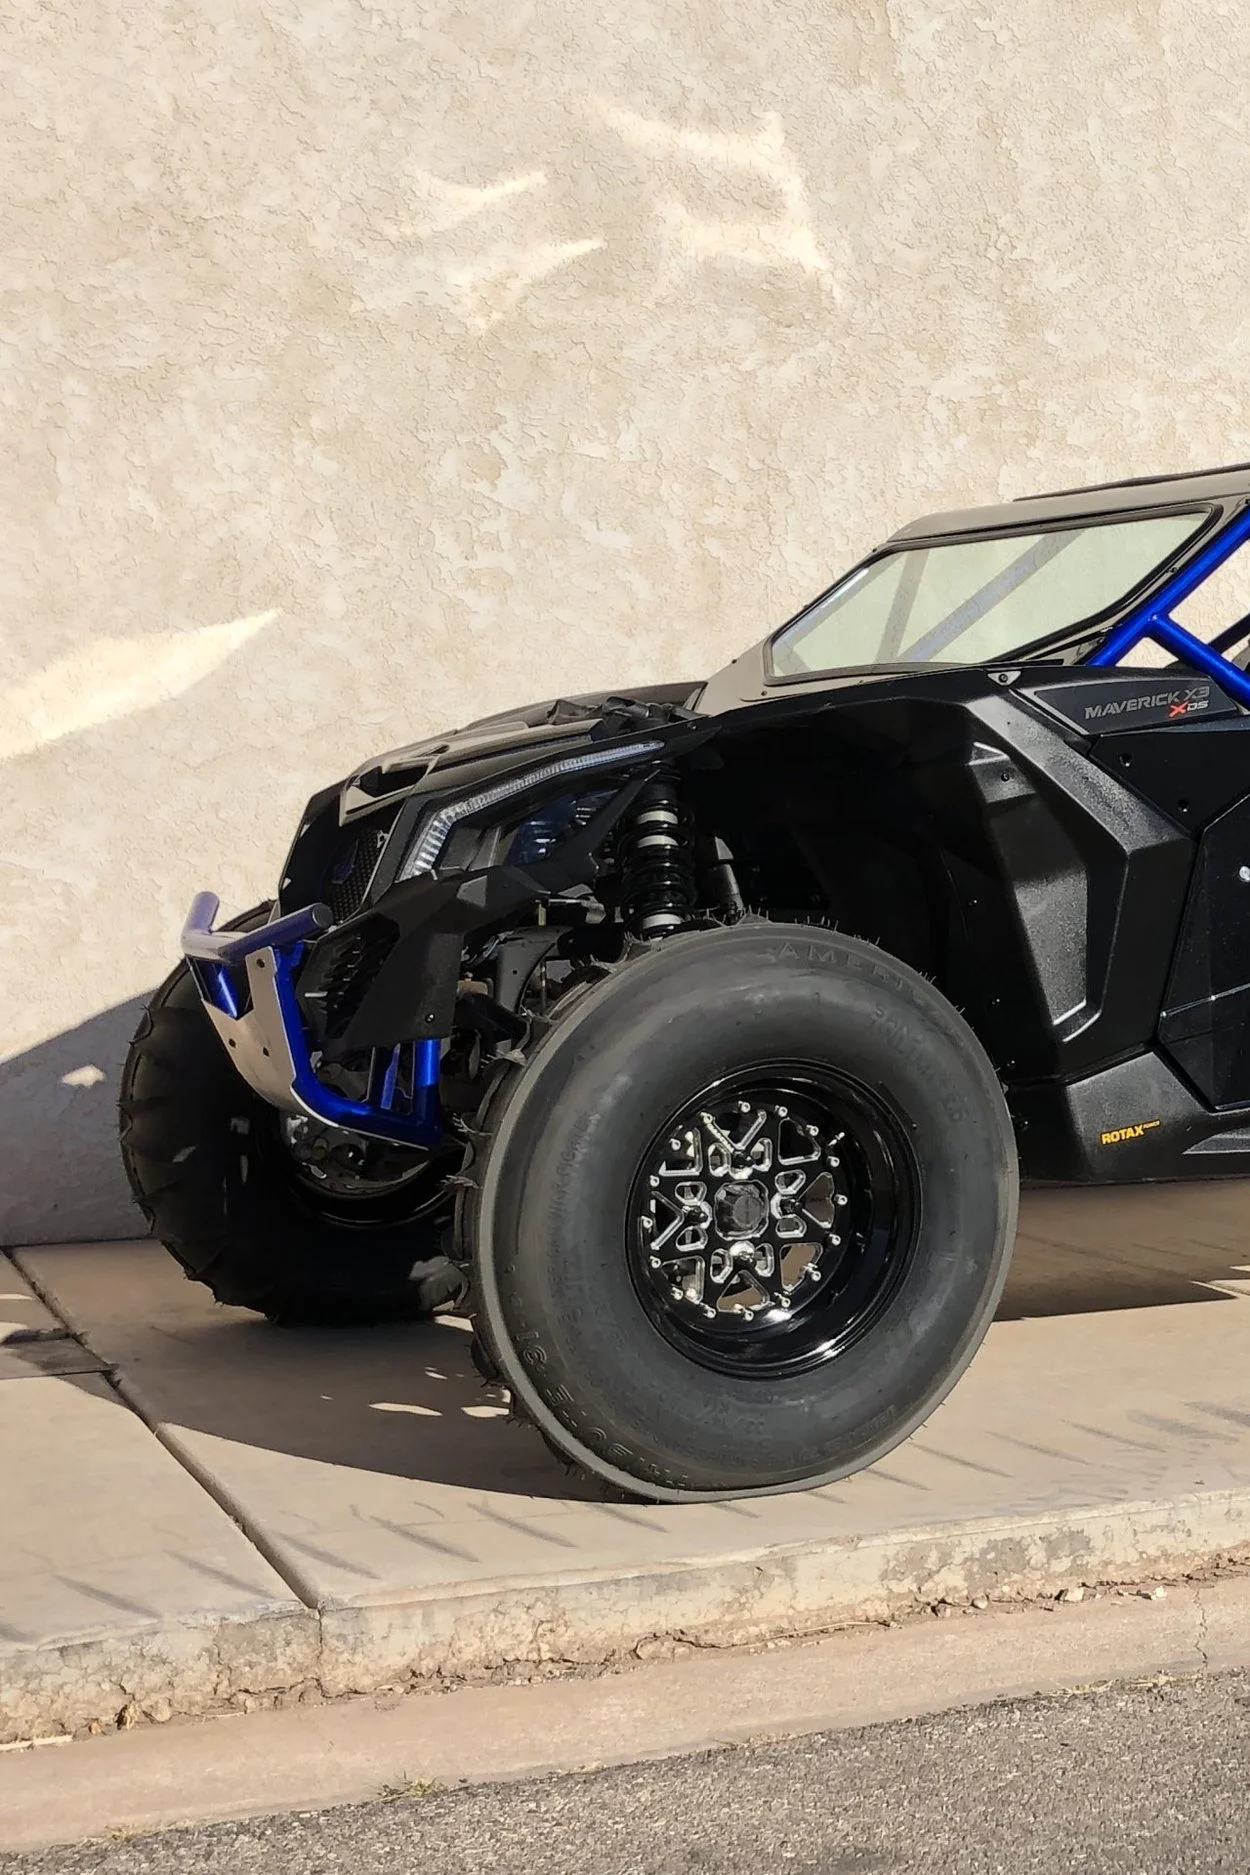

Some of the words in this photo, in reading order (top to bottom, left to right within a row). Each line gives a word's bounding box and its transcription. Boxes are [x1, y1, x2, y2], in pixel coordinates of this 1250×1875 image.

[1084, 690, 1180, 719] MAVERICK
[1183, 686, 1210, 701] X3
[1101, 1124, 1144, 1145] ROTAX
